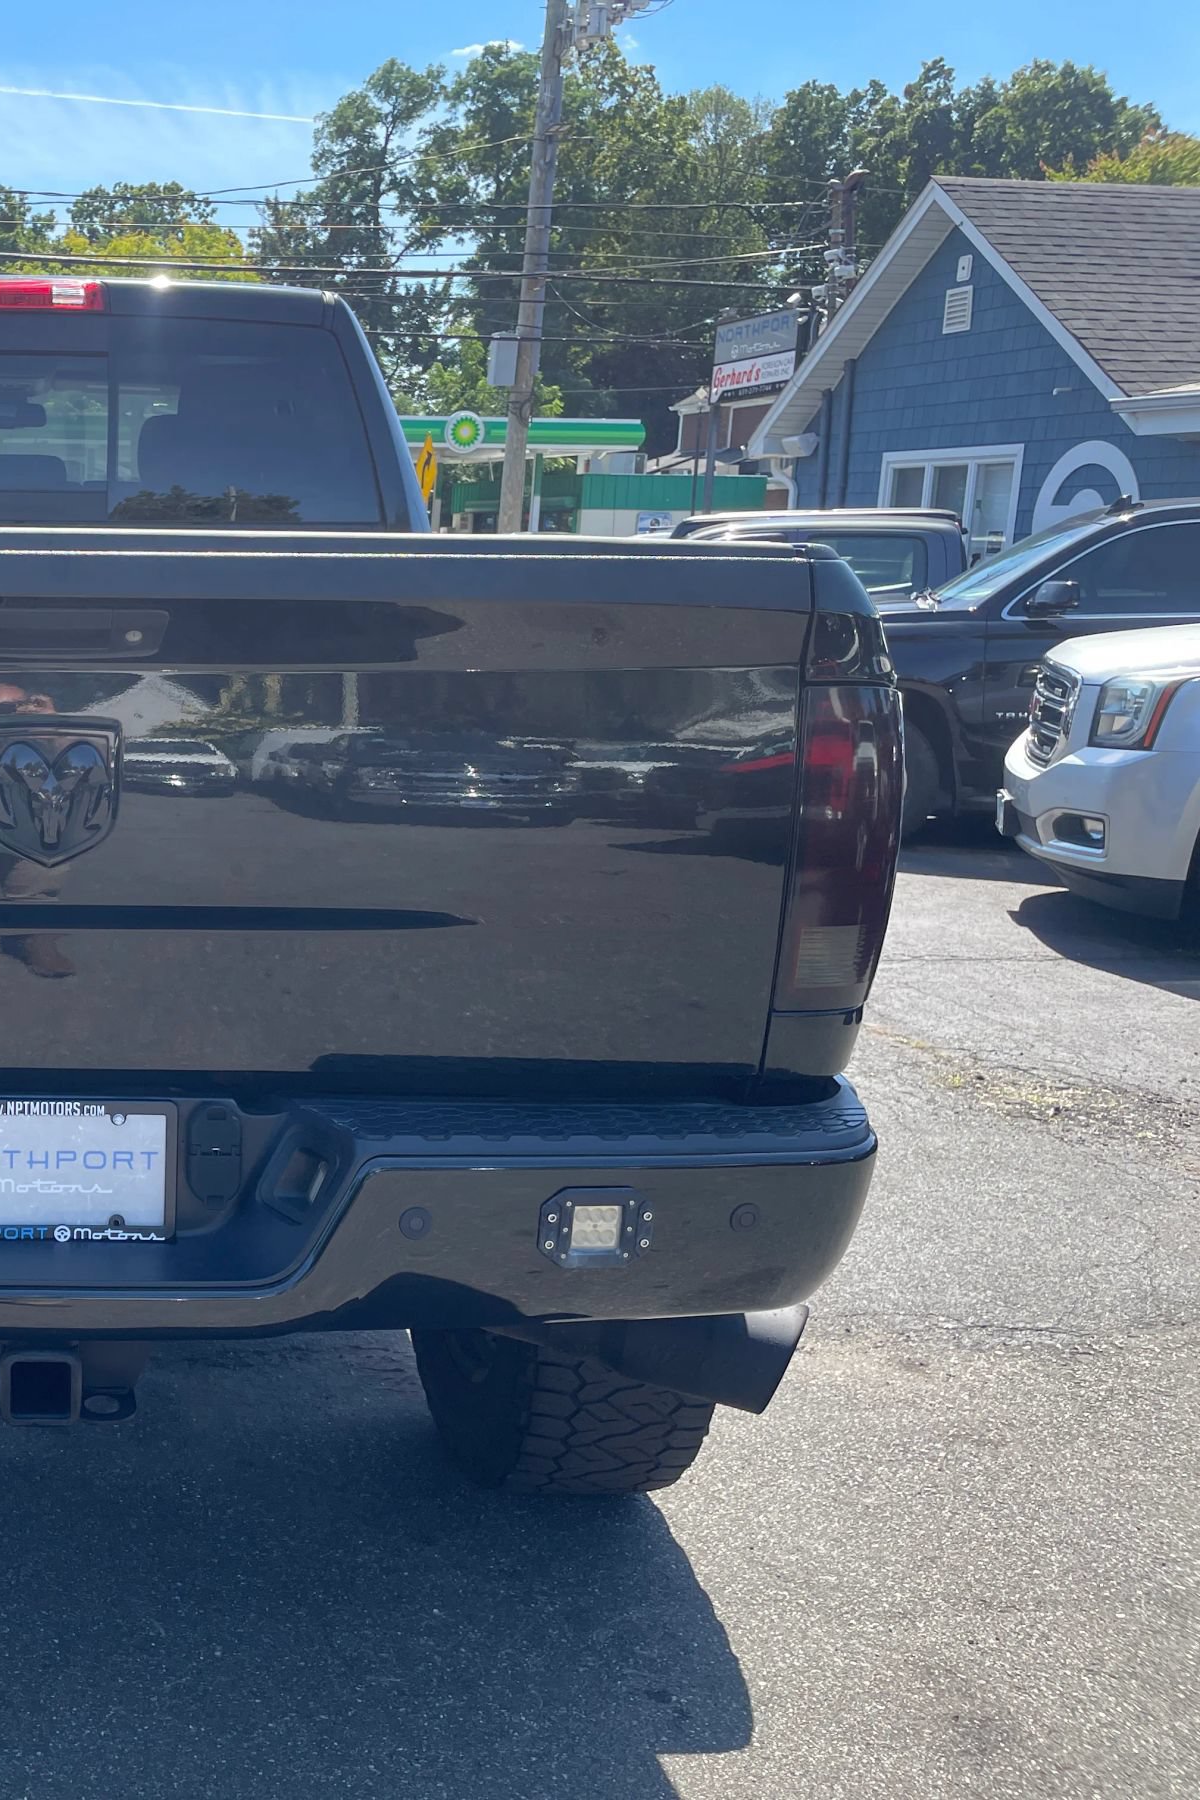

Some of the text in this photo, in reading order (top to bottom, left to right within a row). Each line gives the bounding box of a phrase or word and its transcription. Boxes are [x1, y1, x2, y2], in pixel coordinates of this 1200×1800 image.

[714, 362, 761, 394] Gerhard's
[995, 711, 1028, 719] TAH
[73, 1227, 166, 1241] Motors
